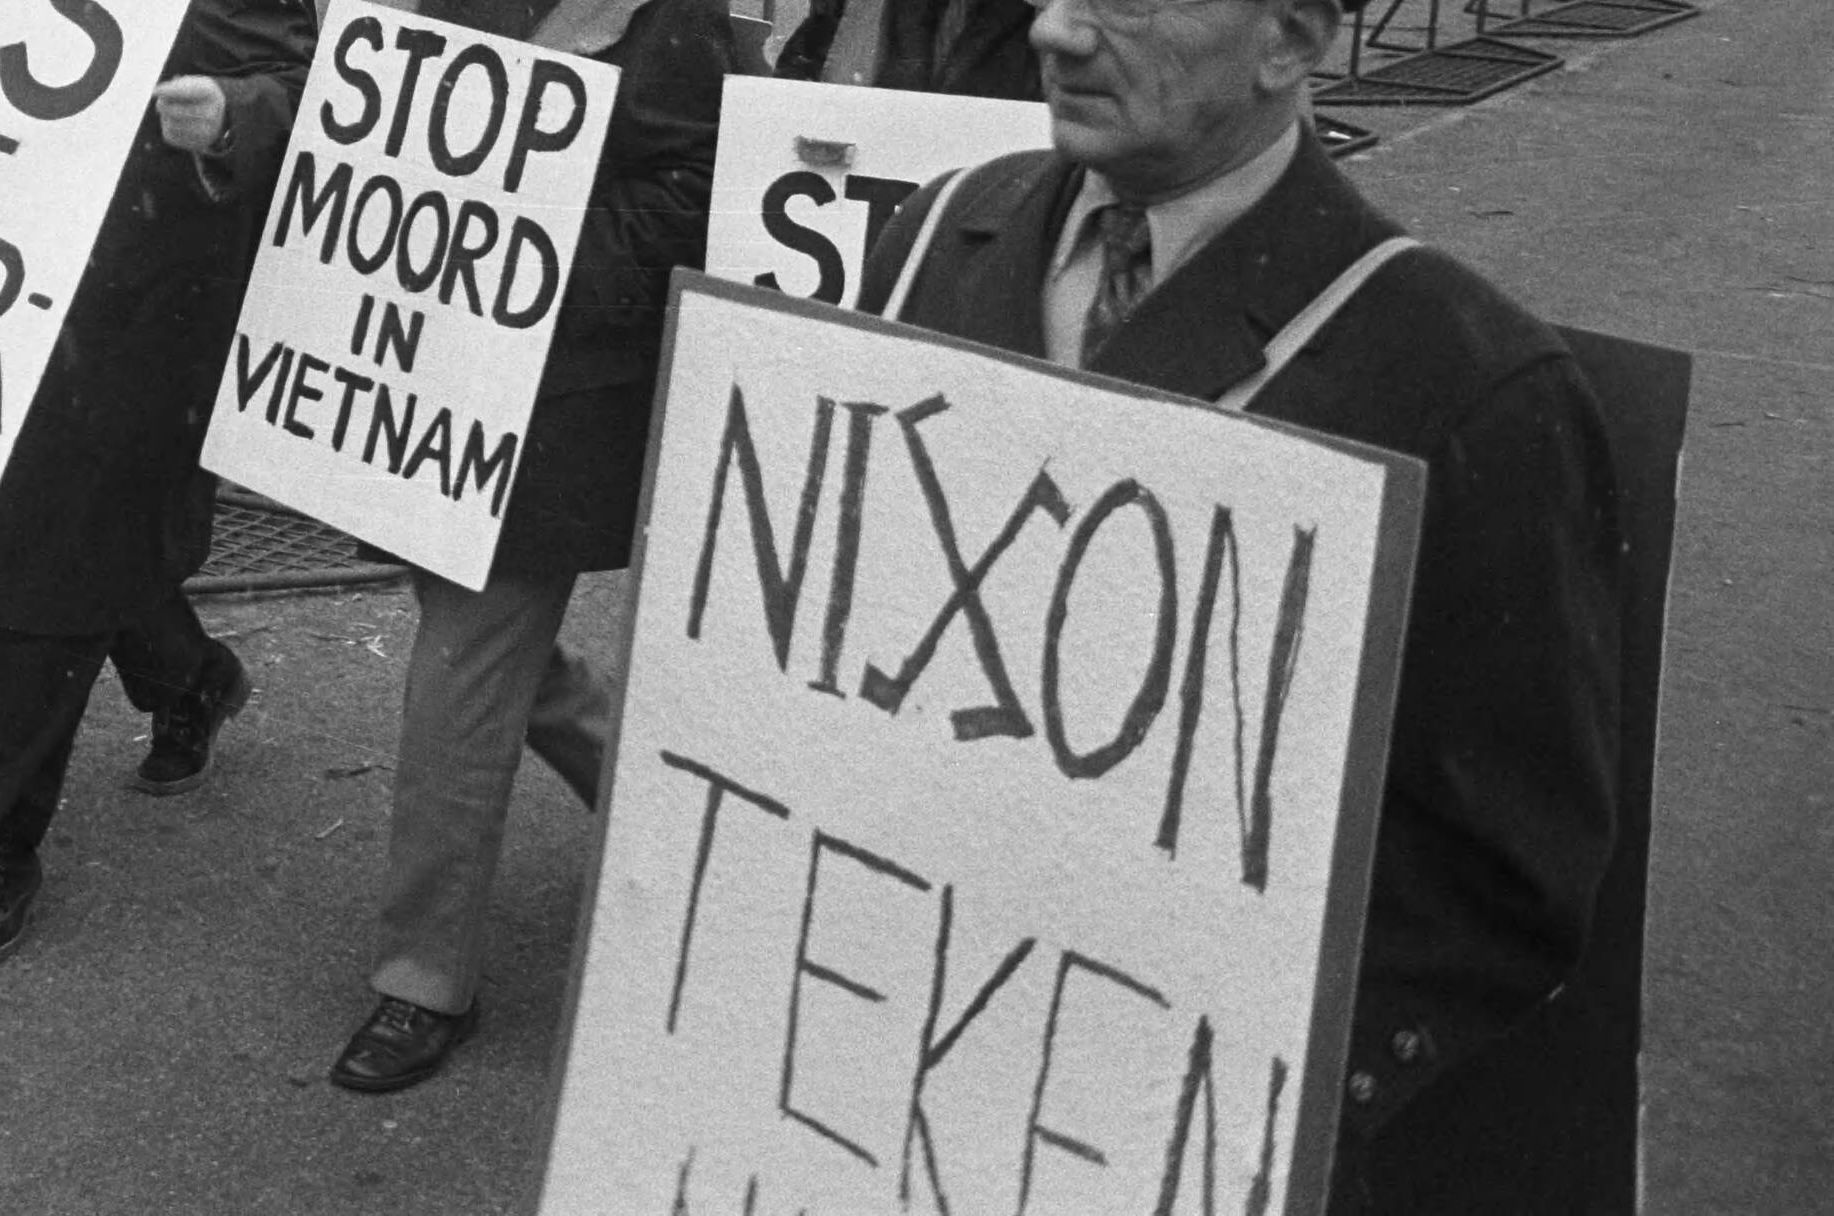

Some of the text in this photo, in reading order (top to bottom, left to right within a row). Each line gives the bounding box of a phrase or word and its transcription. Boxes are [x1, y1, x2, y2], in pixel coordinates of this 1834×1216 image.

[319, 15, 588, 193] STOP
[272, 151, 560, 330] MOORD
[350, 293, 424, 373] IN
[235, 333, 519, 519] VIETNAM
[687, 381, 1316, 895] NIXON
